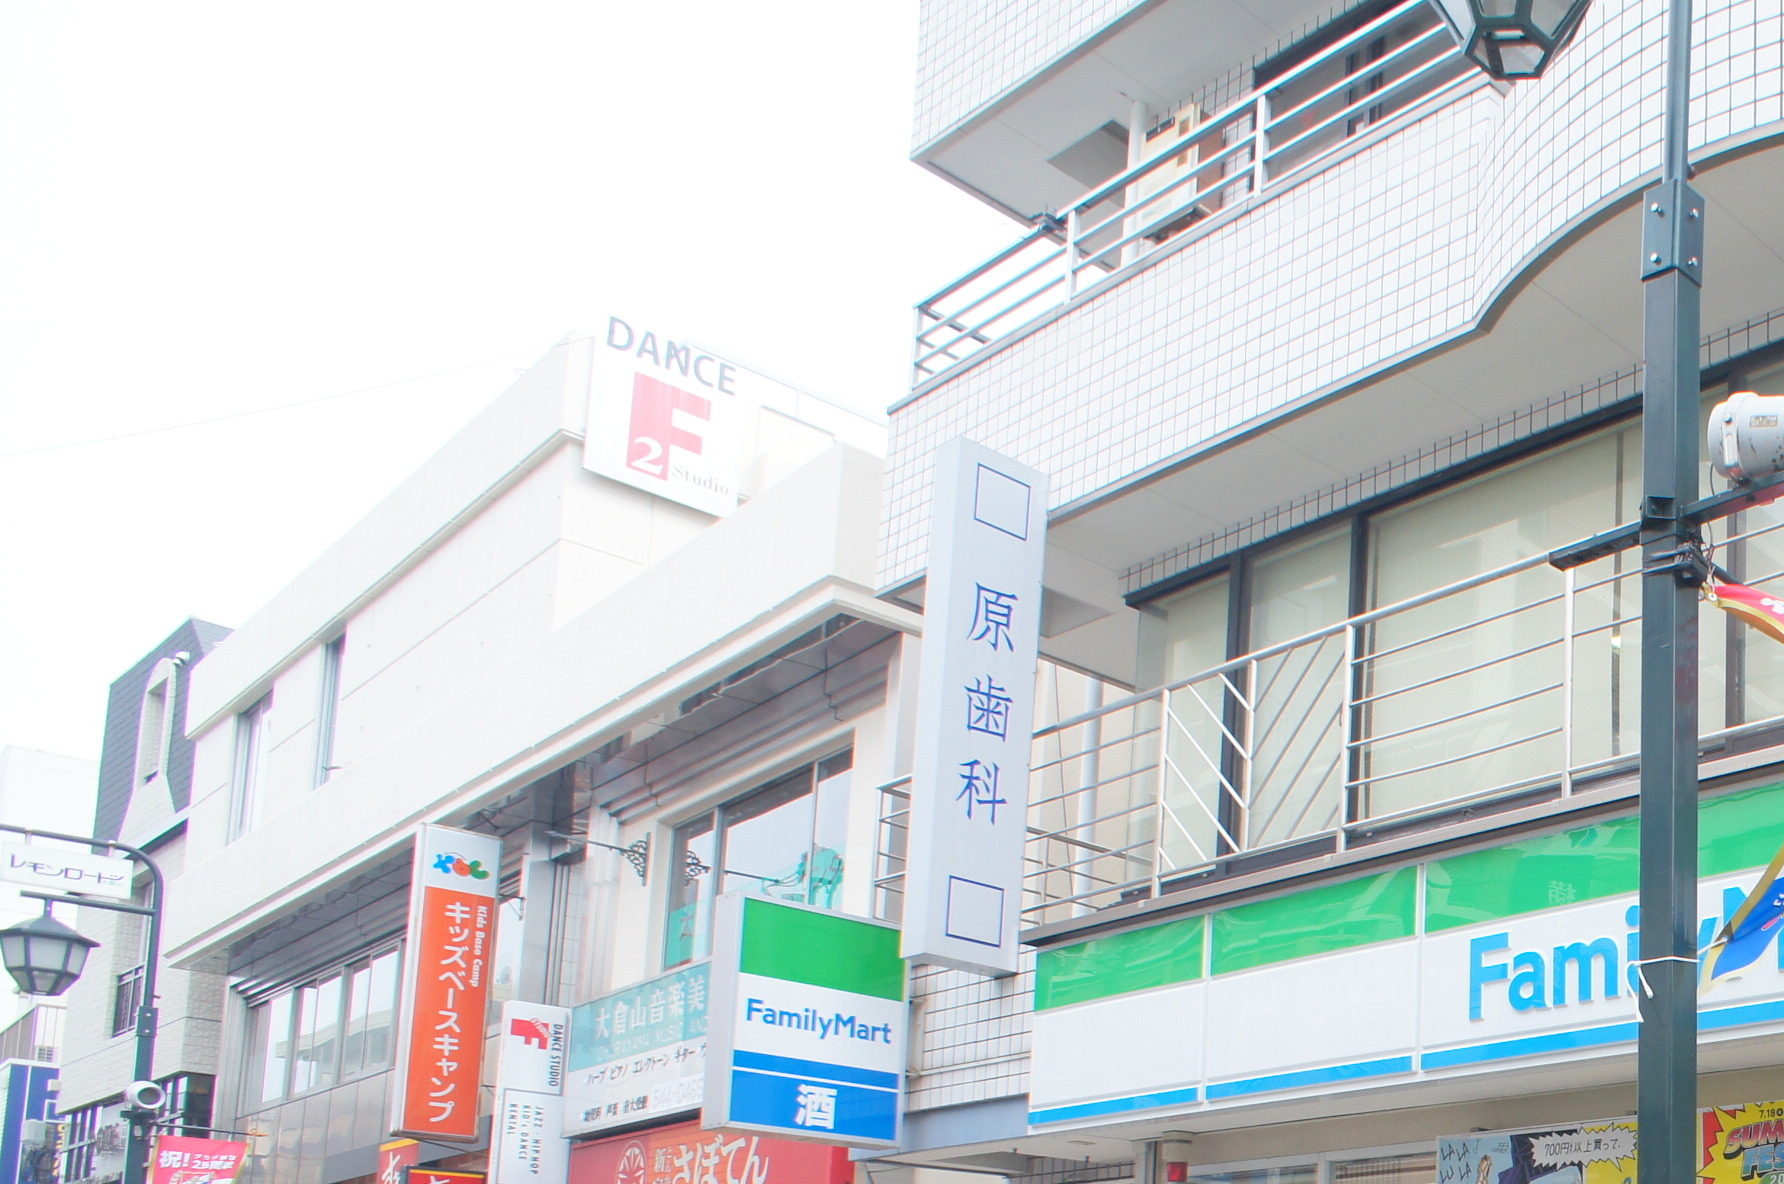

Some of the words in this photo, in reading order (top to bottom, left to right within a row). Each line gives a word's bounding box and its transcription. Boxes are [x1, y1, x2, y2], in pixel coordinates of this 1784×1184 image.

[606, 316, 736, 397] DANCE
[631, 436, 664, 476] 2
[672, 463, 730, 497] Studio
[10, 853, 125, 885] レモンロード
[476, 905, 488, 928] Kids
[469, 959, 483, 987] Camp
[428, 901, 471, 1123] キッズベースキャンプ
[746, 997, 893, 1046] FamilyMart
[551, 1023, 564, 1051] DANCE
[548, 1054, 561, 1087] STUDIO
[507, 1103, 519, 1135] RENTAL
[533, 1106, 544, 1128] JAZZ
[796, 1083, 838, 1130] 酒
